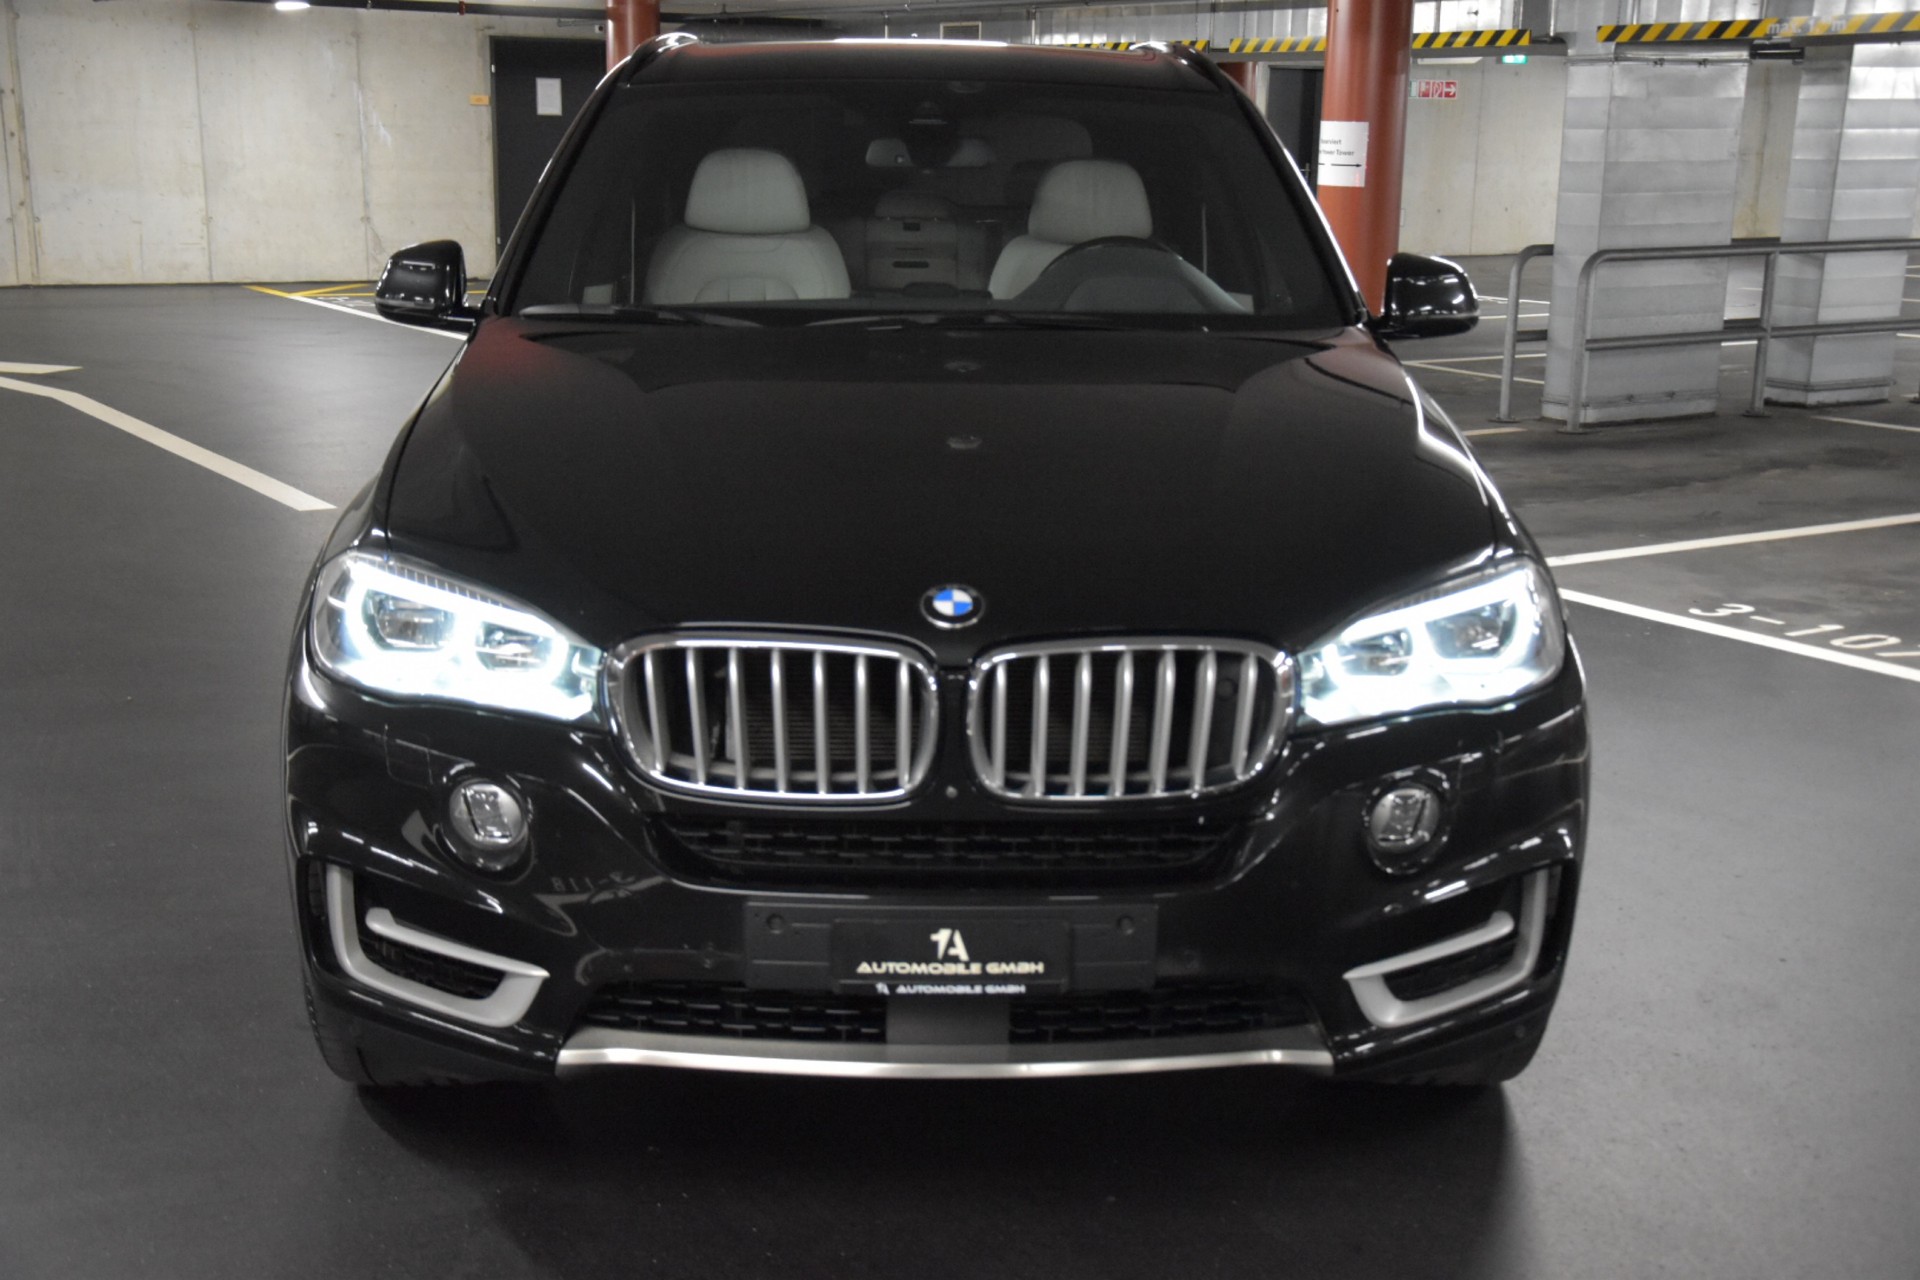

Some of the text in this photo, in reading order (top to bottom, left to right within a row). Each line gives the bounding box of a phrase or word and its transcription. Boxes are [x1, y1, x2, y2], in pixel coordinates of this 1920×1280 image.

[930, 928, 969, 961] 1A
[856, 961, 982, 975] AUTOMOBILE
[895, 984, 983, 995] AUTOMOBILE
